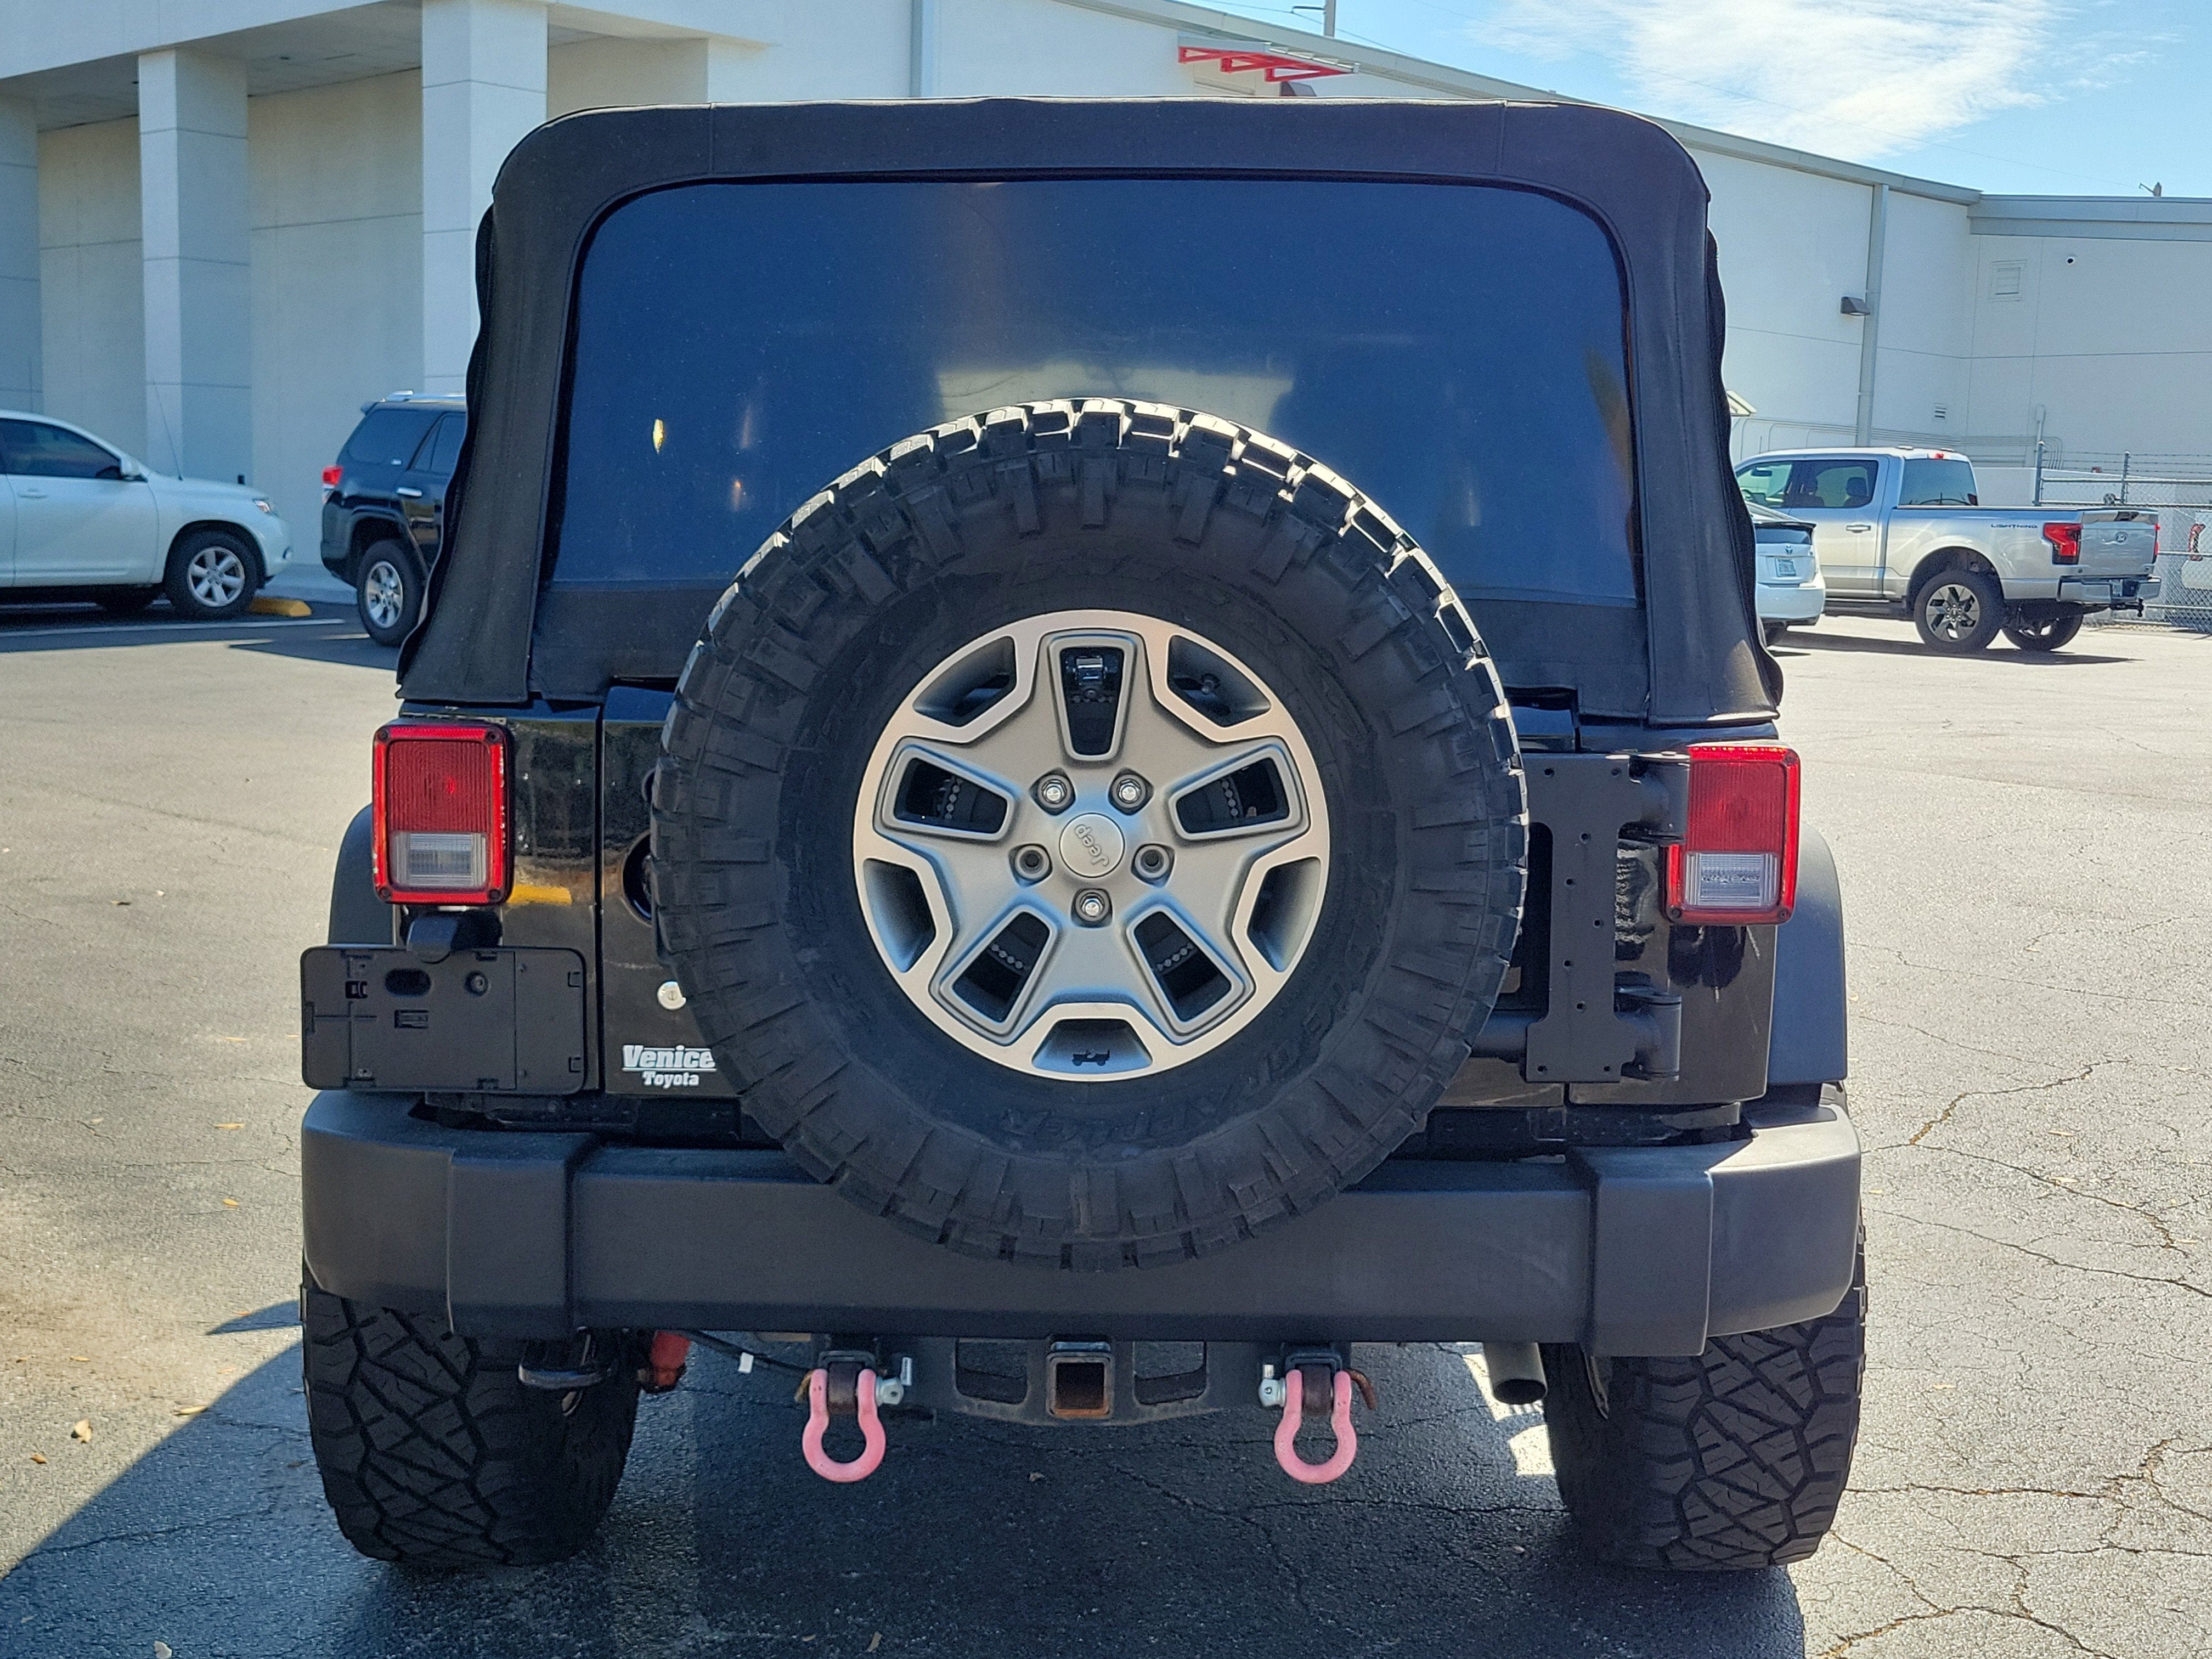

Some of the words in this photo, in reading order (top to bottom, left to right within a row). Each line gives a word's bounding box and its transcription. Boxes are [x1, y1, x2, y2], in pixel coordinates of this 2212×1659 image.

[1074, 823, 1110, 867] Jeep
[622, 1045, 715, 1068] Venice
[642, 1071, 699, 1089] Toyota
